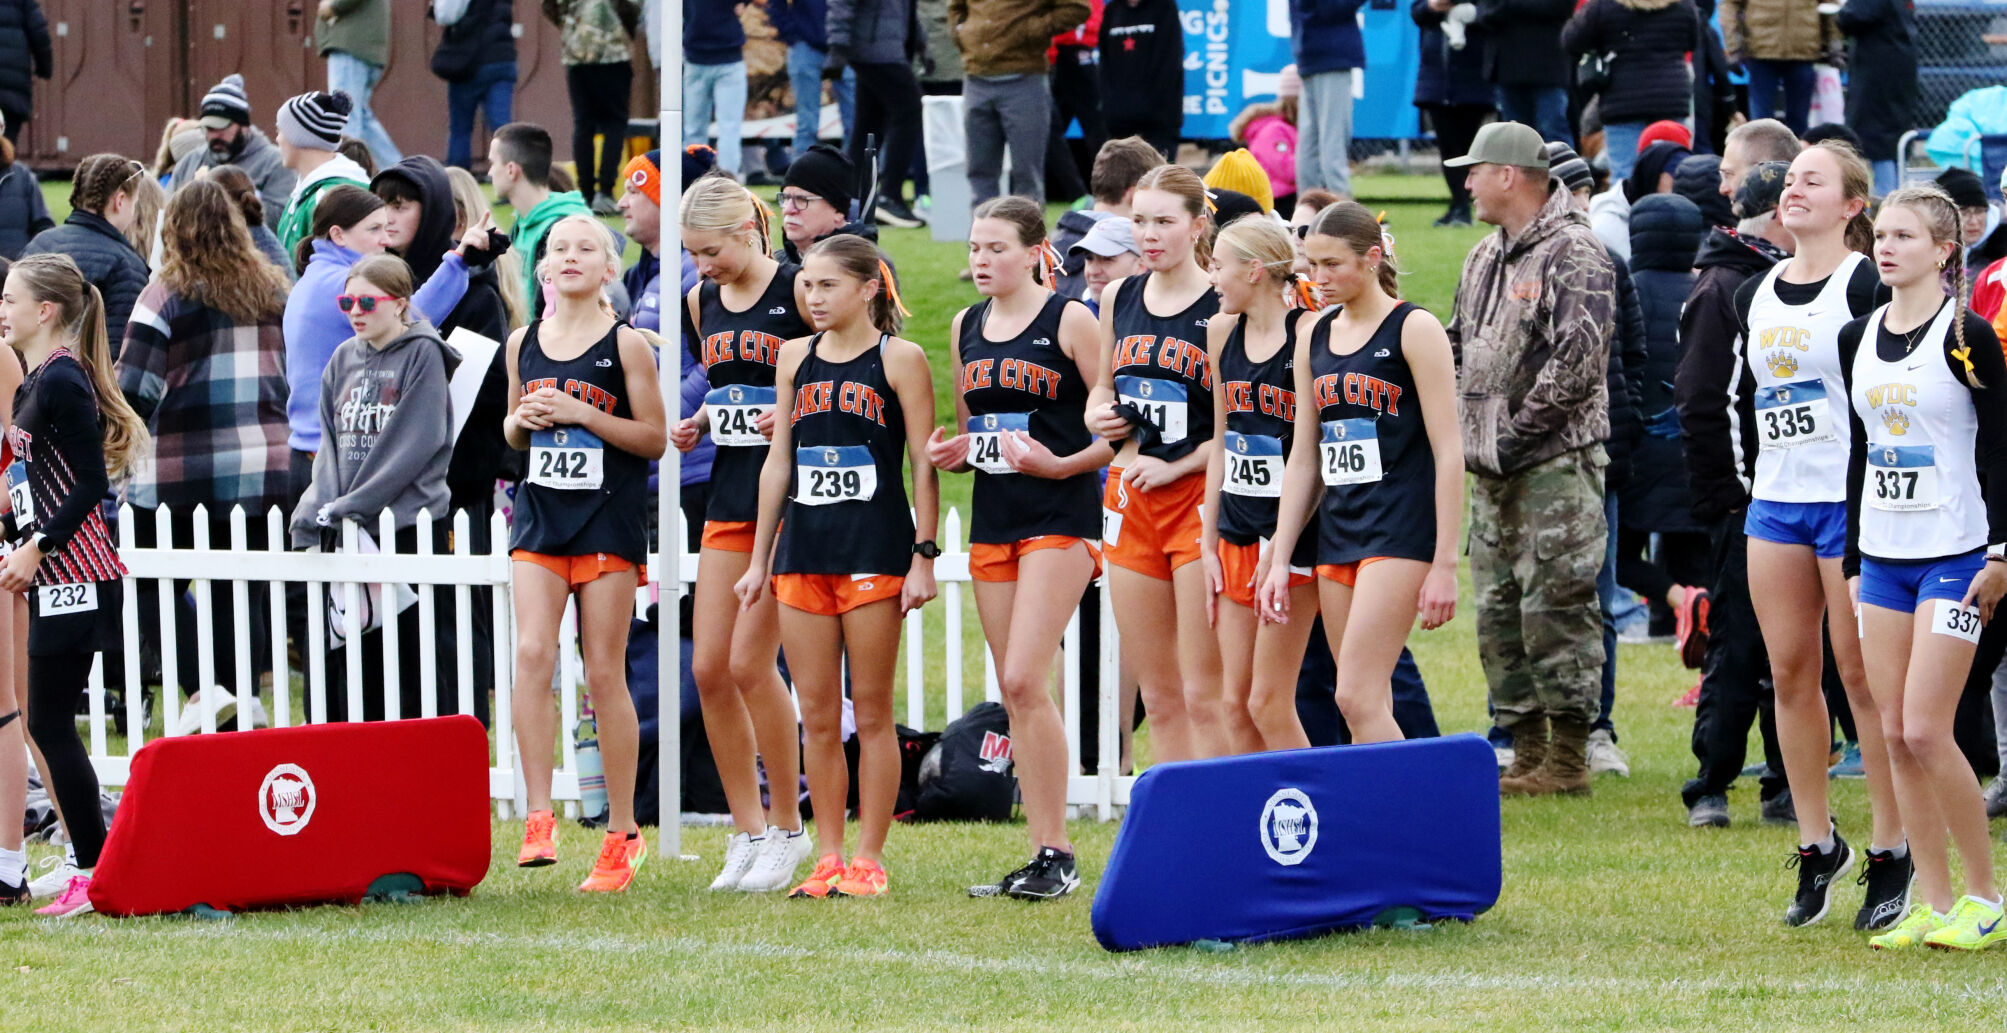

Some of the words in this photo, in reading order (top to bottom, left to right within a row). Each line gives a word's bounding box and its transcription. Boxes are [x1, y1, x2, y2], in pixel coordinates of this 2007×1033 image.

[739, 329, 787, 367] CIT
[1760, 326, 1811, 352] WDC
[962, 358, 995, 395] KE
[999, 357, 1062, 400] CITY
[1258, 382, 1297, 423] CIT
[1343, 372, 1403, 417] CITY
[1865, 383, 1917, 409] WDC
[718, 407, 763, 435] 243
[1765, 405, 1816, 440] 335
[539, 450, 588, 478] 242
[975, 435, 1004, 463] 24
[1327, 444, 1366, 474] 246
[810, 470, 861, 497] 239
[1230, 455, 1271, 486] 245
[1875, 470, 1919, 500] 337
[50, 584, 88, 609] 232
[1946, 607, 1981, 636] 337
[979, 729, 1013, 763] M
